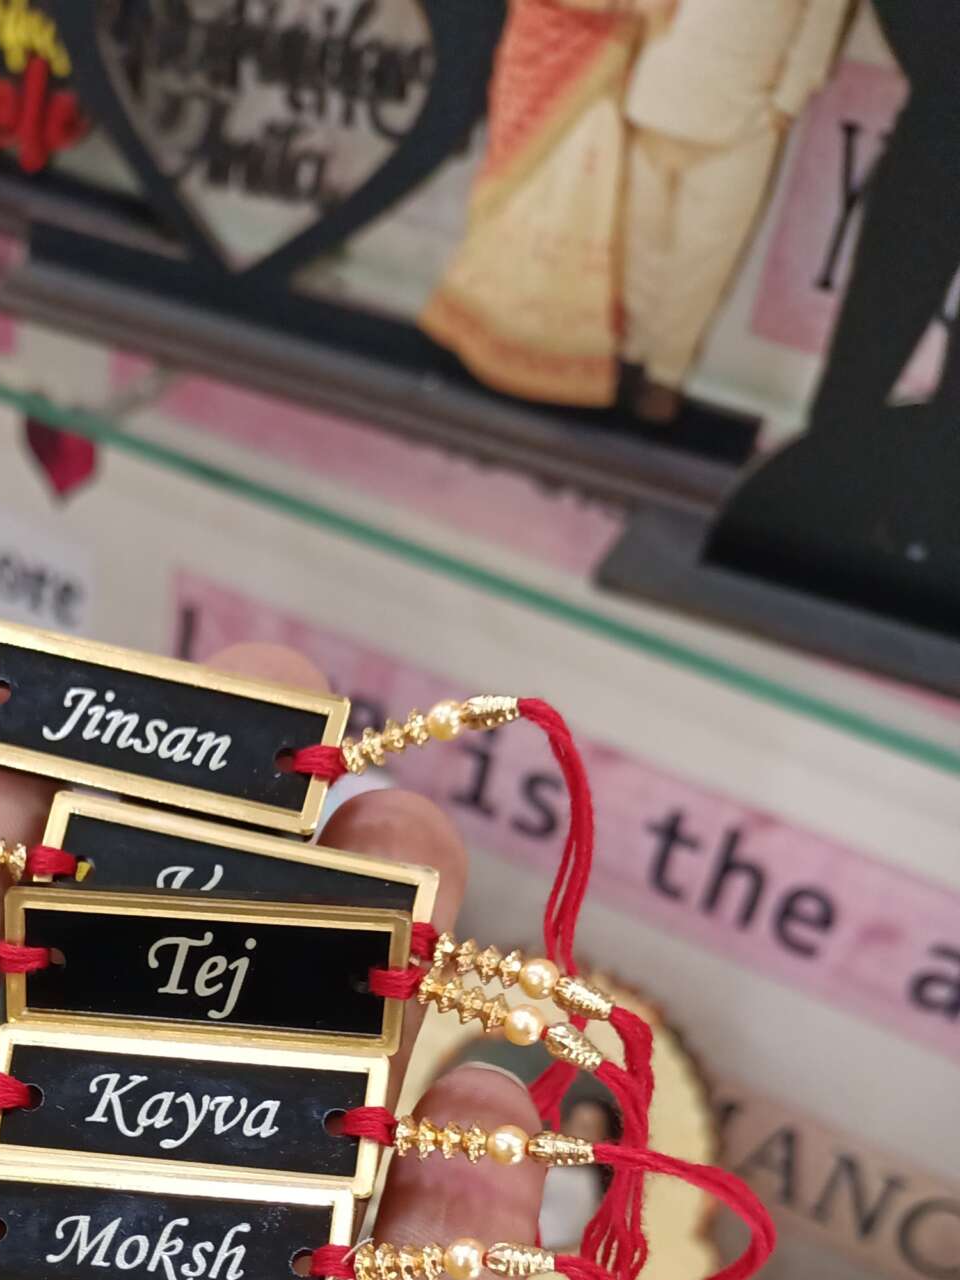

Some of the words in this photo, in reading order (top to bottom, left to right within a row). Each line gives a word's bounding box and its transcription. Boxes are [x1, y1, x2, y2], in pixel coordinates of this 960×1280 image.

[42, 687, 232, 770] Jinsan
[644, 805, 838, 960] the
[148, 931, 257, 1019] Tej
[84, 1072, 281, 1149] Kayva
